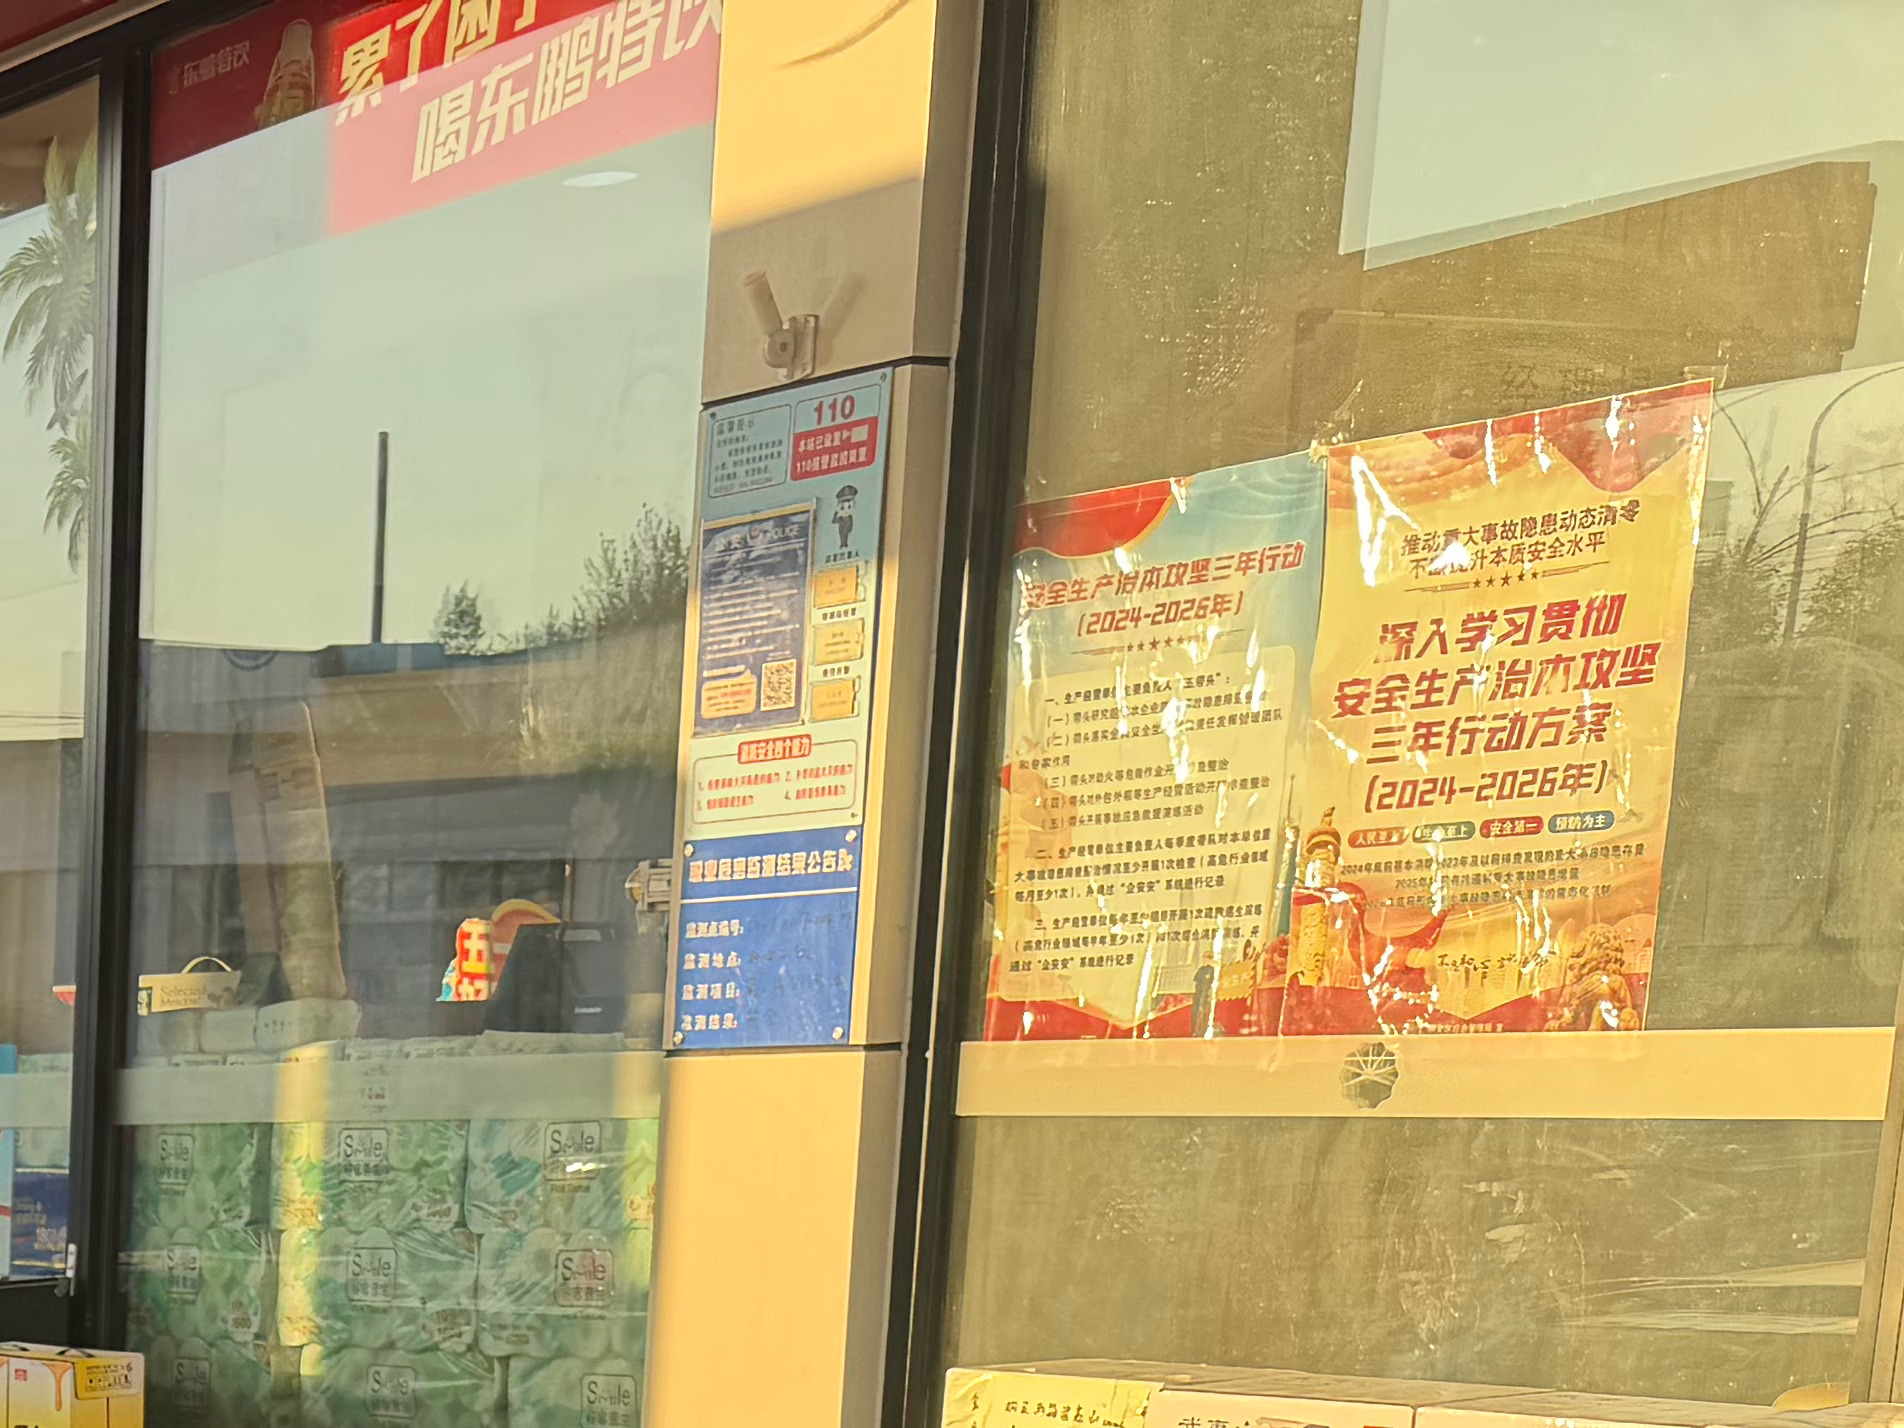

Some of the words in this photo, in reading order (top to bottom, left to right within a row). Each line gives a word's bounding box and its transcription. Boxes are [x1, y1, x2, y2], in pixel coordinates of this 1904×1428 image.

[814, 395, 855, 425] 110
[1025, 541, 1305, 609] 安全生产治本攻坚三年行动
[1374, 593, 1627, 664] 深入学习贯彻
[1330, 641, 1663, 718] 安全生产治本攻坚
[1367, 702, 1612, 764] 三年行动方案
[1490, 820, 1537, 836] 安全第一
[1555, 814, 1606, 831] 预防为主
